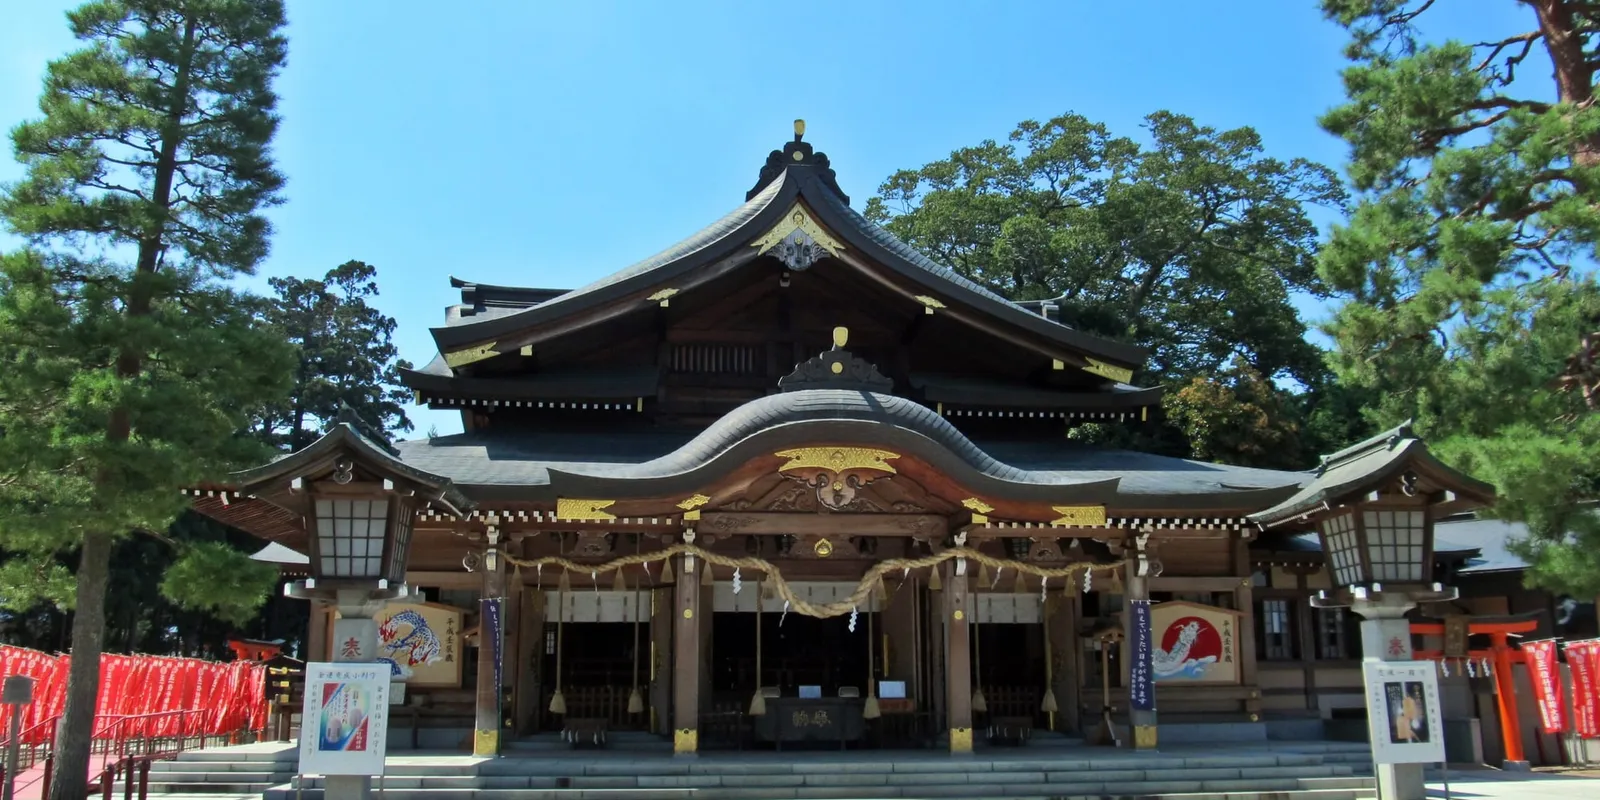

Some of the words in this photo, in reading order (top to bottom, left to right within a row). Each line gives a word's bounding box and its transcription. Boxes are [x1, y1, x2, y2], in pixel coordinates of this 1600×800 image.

[446, 617, 454, 662] 平成壬辰歳
[1223, 620, 1232, 663] 平成壬辰歳
